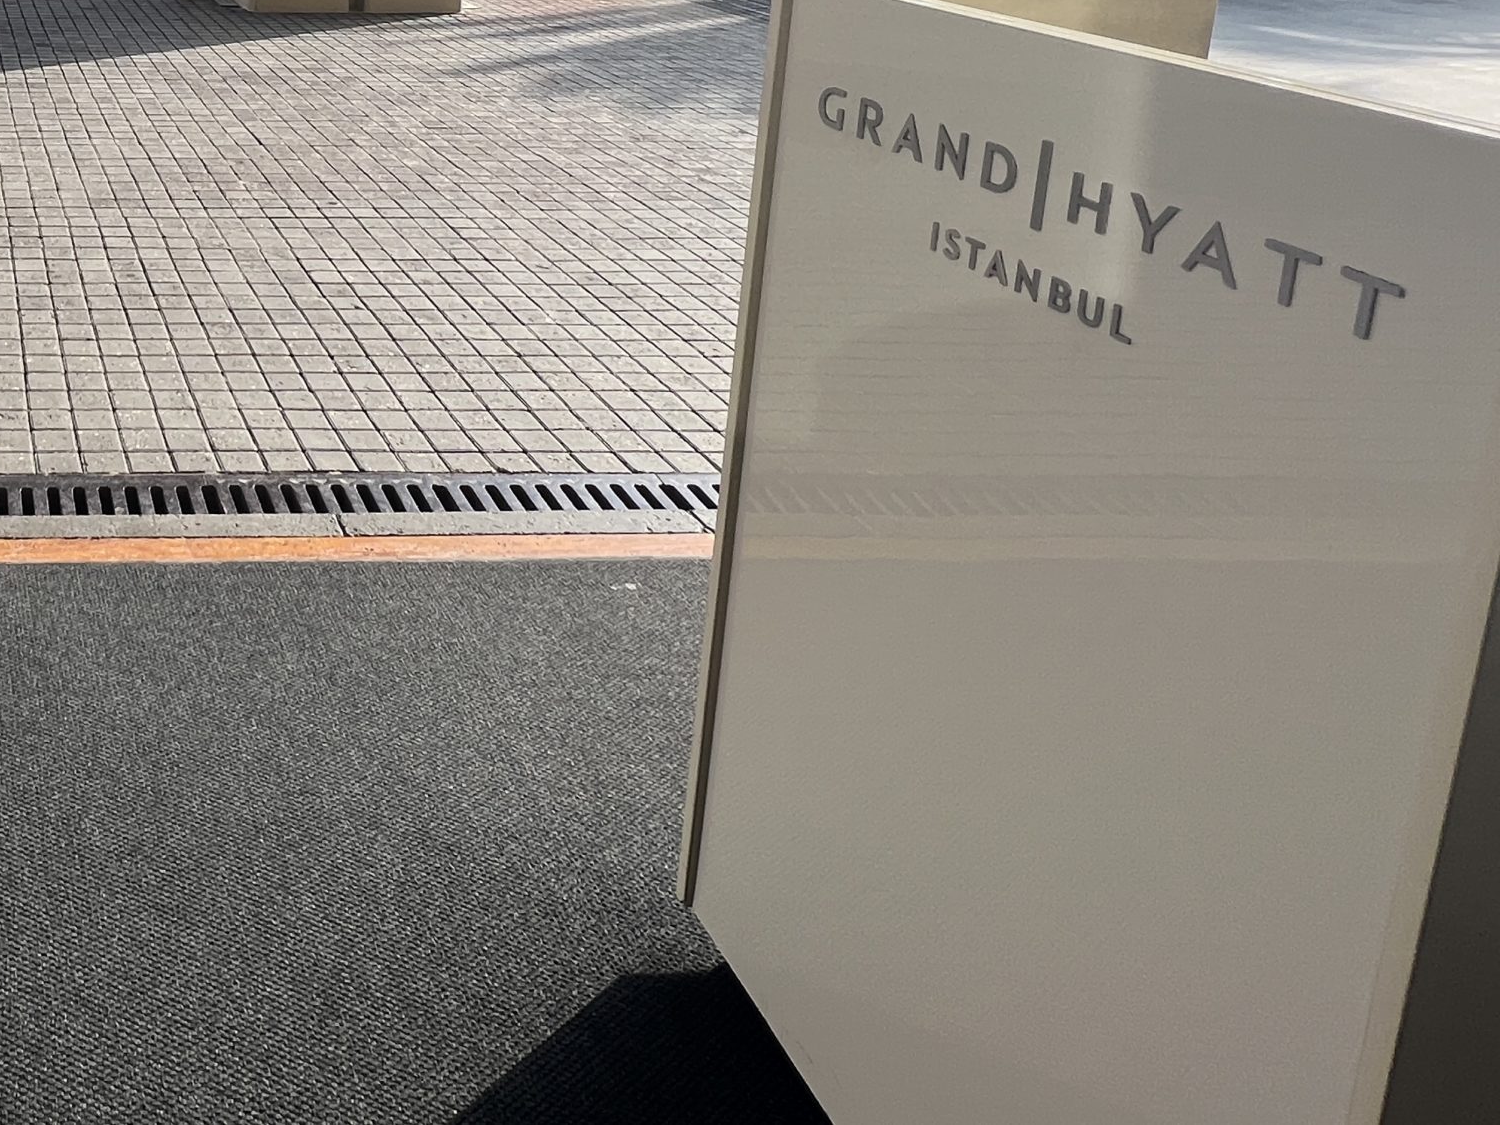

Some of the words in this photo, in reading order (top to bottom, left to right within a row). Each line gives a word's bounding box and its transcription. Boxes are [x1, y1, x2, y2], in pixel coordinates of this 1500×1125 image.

[818, 87, 1018, 194] GRAND
[1066, 172, 1406, 340] HYATT
[930, 221, 1133, 346] ISTANBUL
